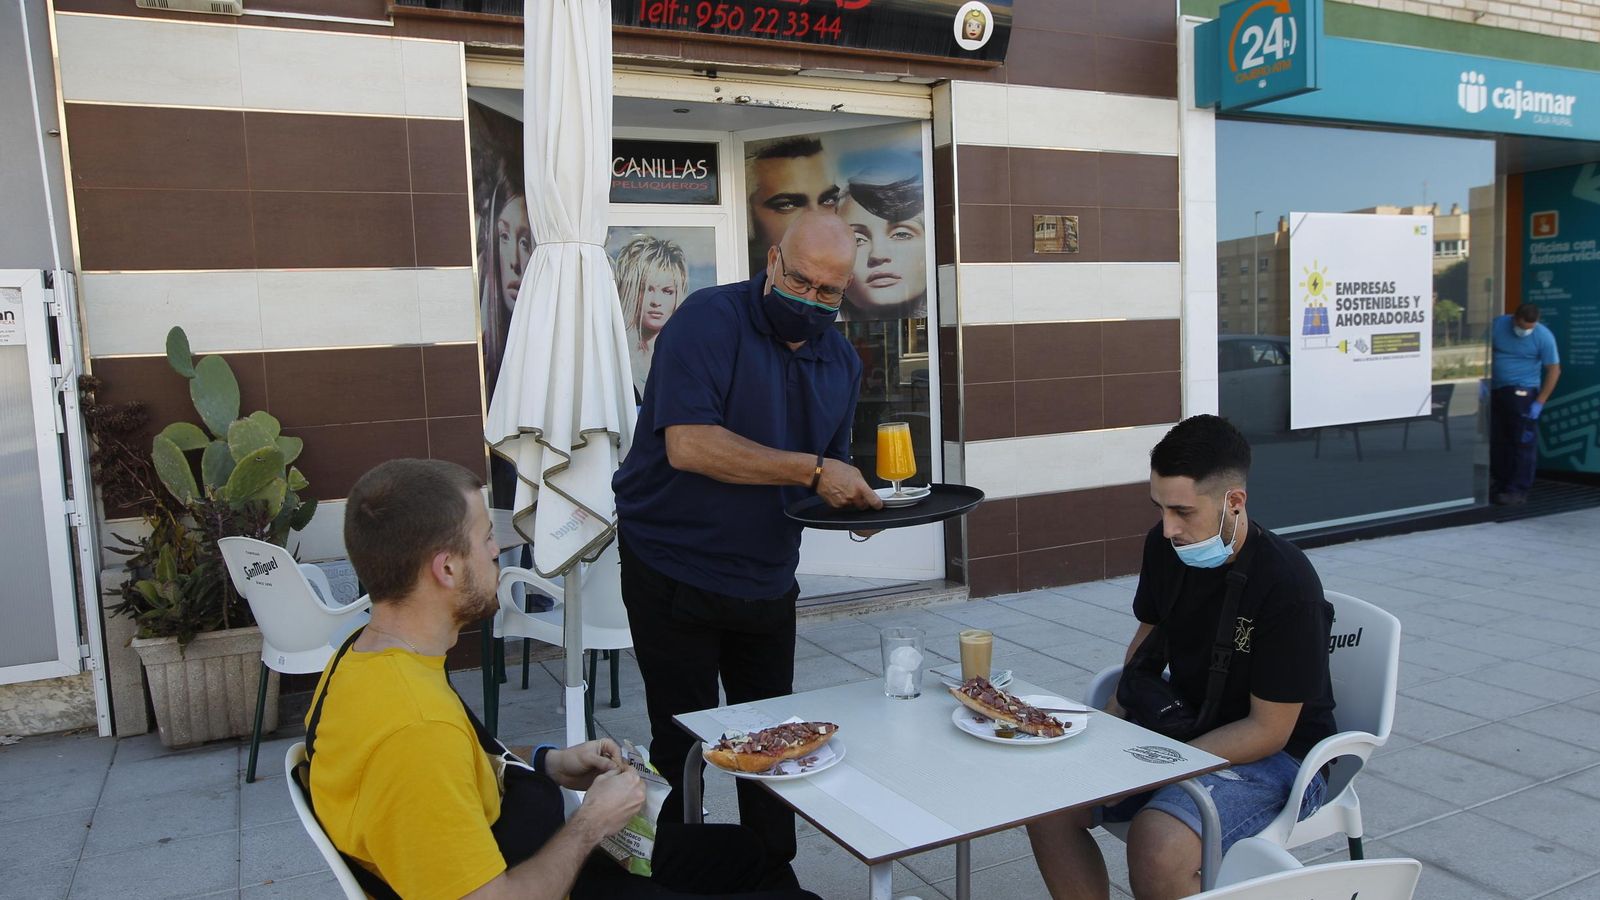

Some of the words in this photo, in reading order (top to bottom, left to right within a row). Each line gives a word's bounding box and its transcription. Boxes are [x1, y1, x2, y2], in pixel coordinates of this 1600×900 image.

[696, 1, 745, 30] 950
[750, 6, 780, 34] 22
[782, 11, 810, 36] 33
[813, 15, 842, 40] 44
[1491, 80, 1576, 120] cajamar
[611, 156, 708, 180] CANILLAS
[612, 180, 709, 191] PELUQUEROS
[1335, 281, 1396, 296] EMPRESAS
[1335, 295, 1411, 312] SOSTENIBLES
[1413, 295, 1421, 309] Y
[1335, 310, 1425, 328] AHORRADORAS
